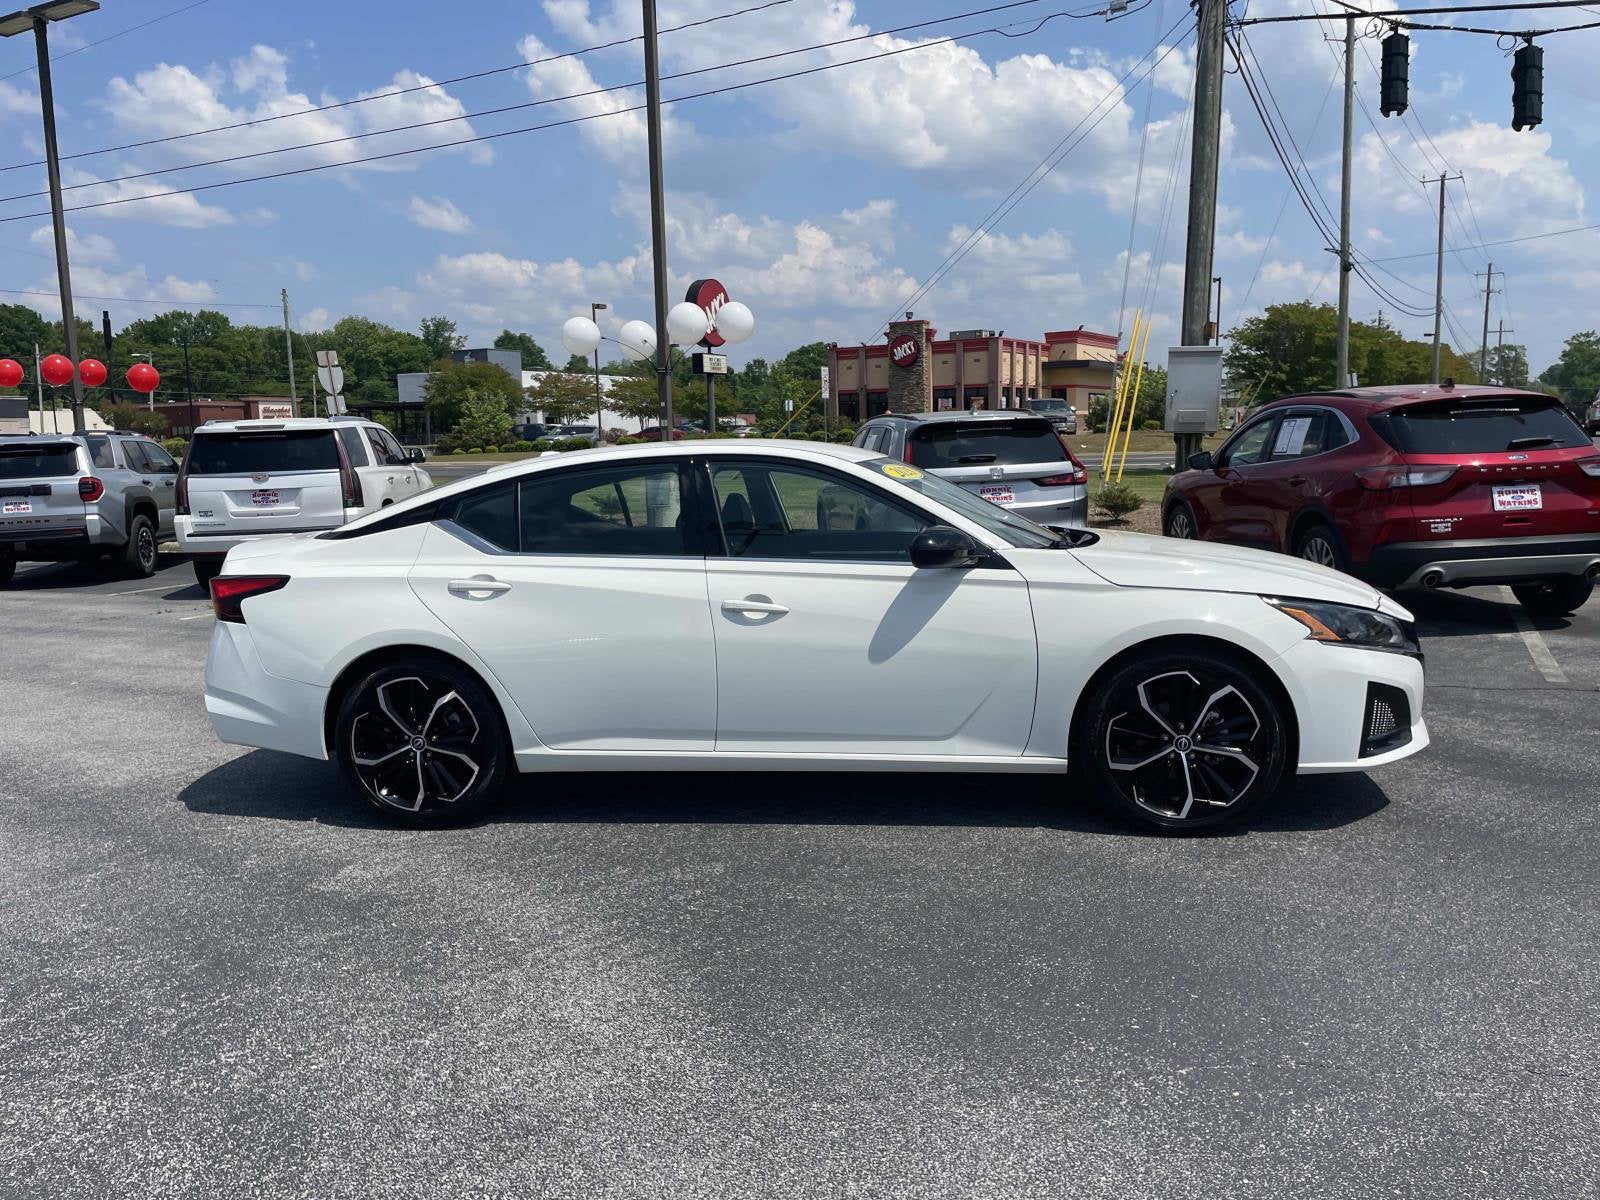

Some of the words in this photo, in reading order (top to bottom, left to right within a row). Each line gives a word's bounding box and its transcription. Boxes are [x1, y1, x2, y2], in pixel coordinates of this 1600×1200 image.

[893, 340, 915, 361] JACK'S
[979, 486, 1012, 495] RONNIE
[1497, 488, 1538, 498] RONNIE
[982, 494, 1013, 502] ATKINS
[1498, 498, 1539, 507] WATKINS
